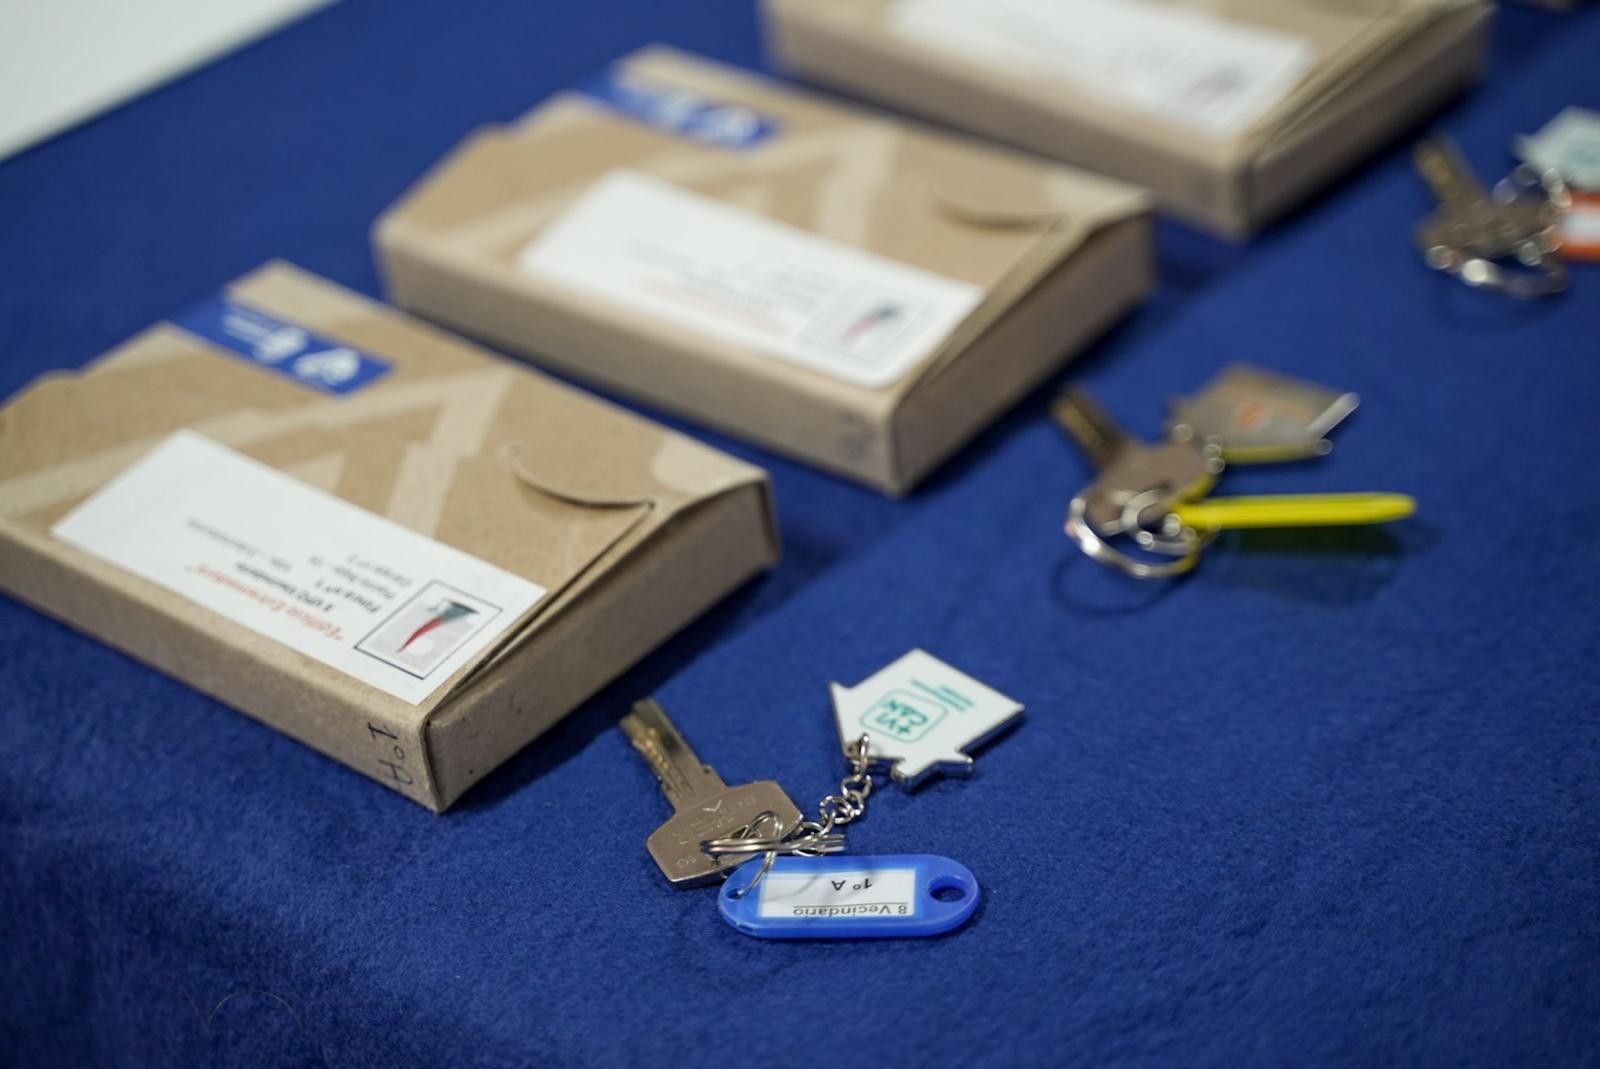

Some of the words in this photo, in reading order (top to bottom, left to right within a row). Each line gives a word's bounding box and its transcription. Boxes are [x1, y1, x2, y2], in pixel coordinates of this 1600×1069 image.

[831, 880, 847, 892] A
[853, 878, 873, 891] 1º
[793, 905, 891, 918] Vecindario
[898, 905, 908, 916] 8
